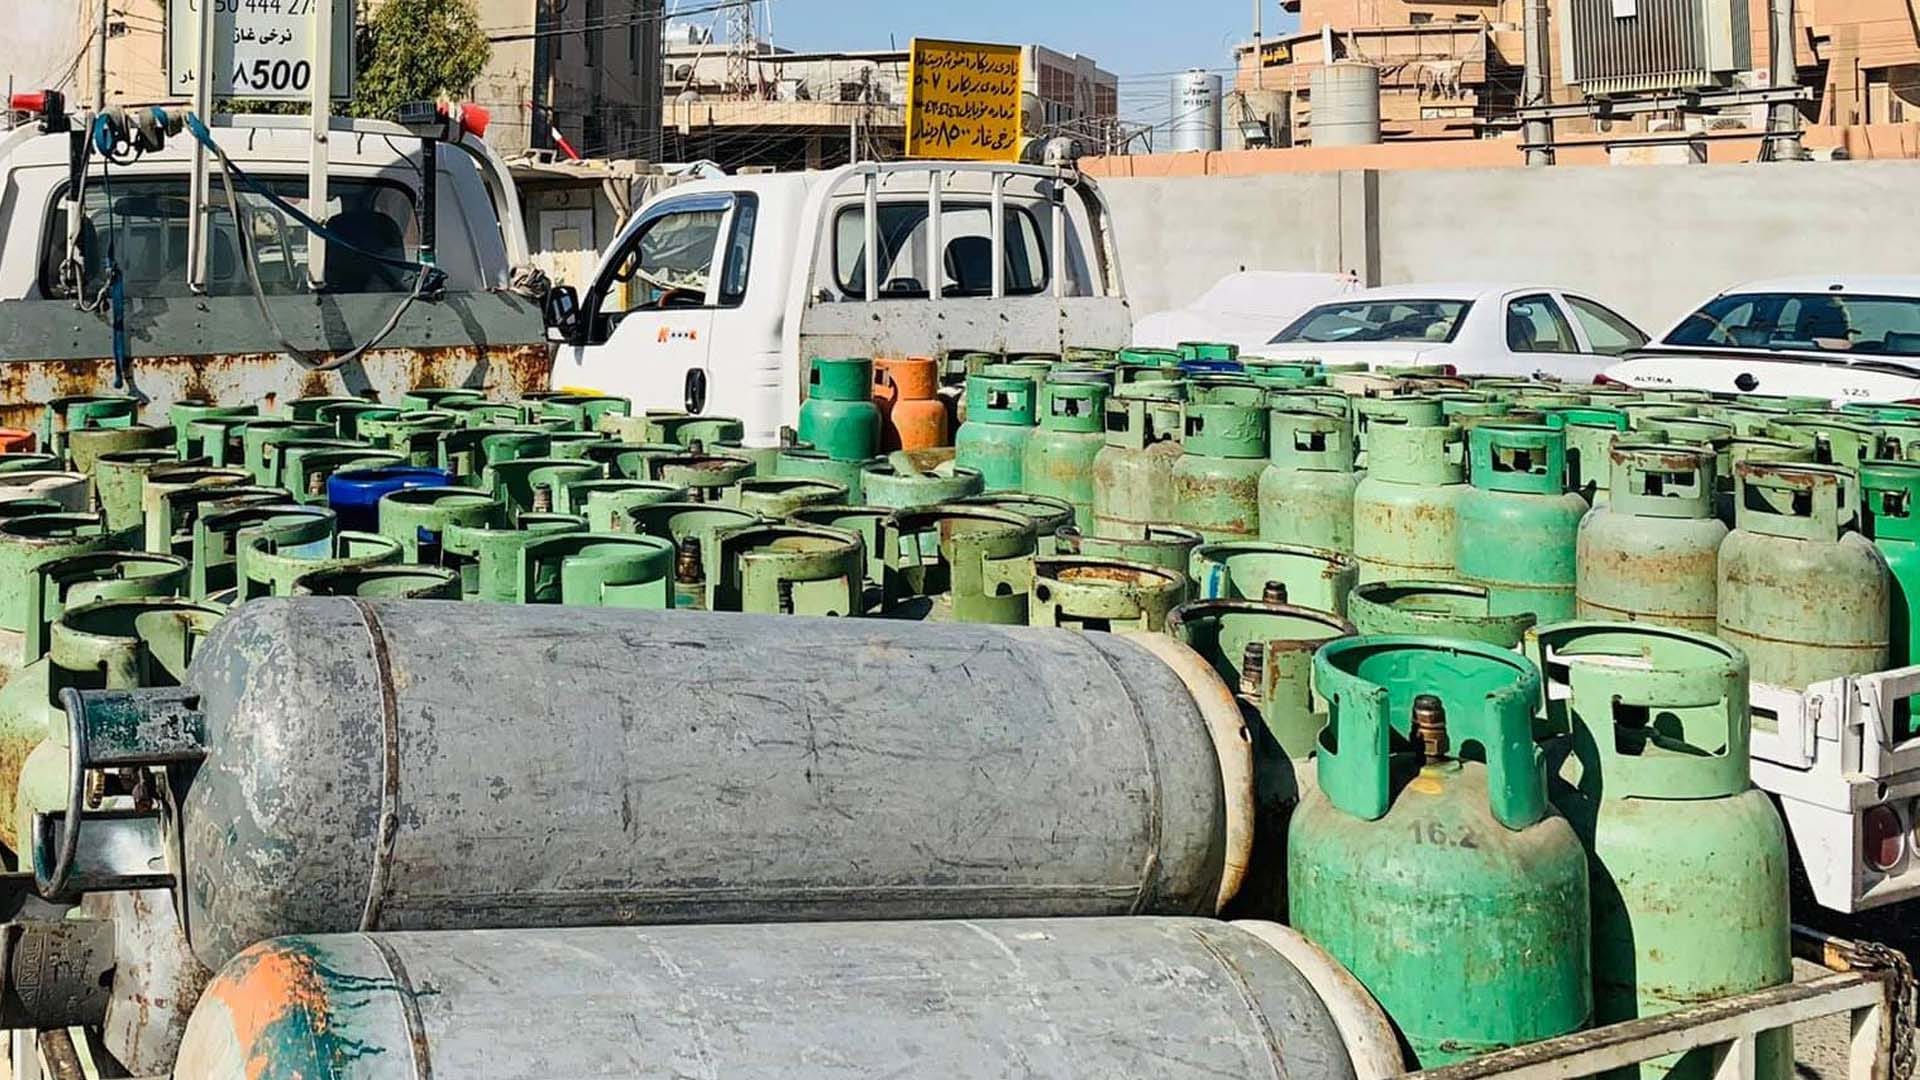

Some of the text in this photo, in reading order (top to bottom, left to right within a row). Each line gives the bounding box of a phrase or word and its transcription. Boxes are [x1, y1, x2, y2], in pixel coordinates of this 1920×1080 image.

[245, 0, 281, 14] 444
[1634, 375, 1673, 385] ALTIMA
[1407, 819, 1479, 849] 16.2
